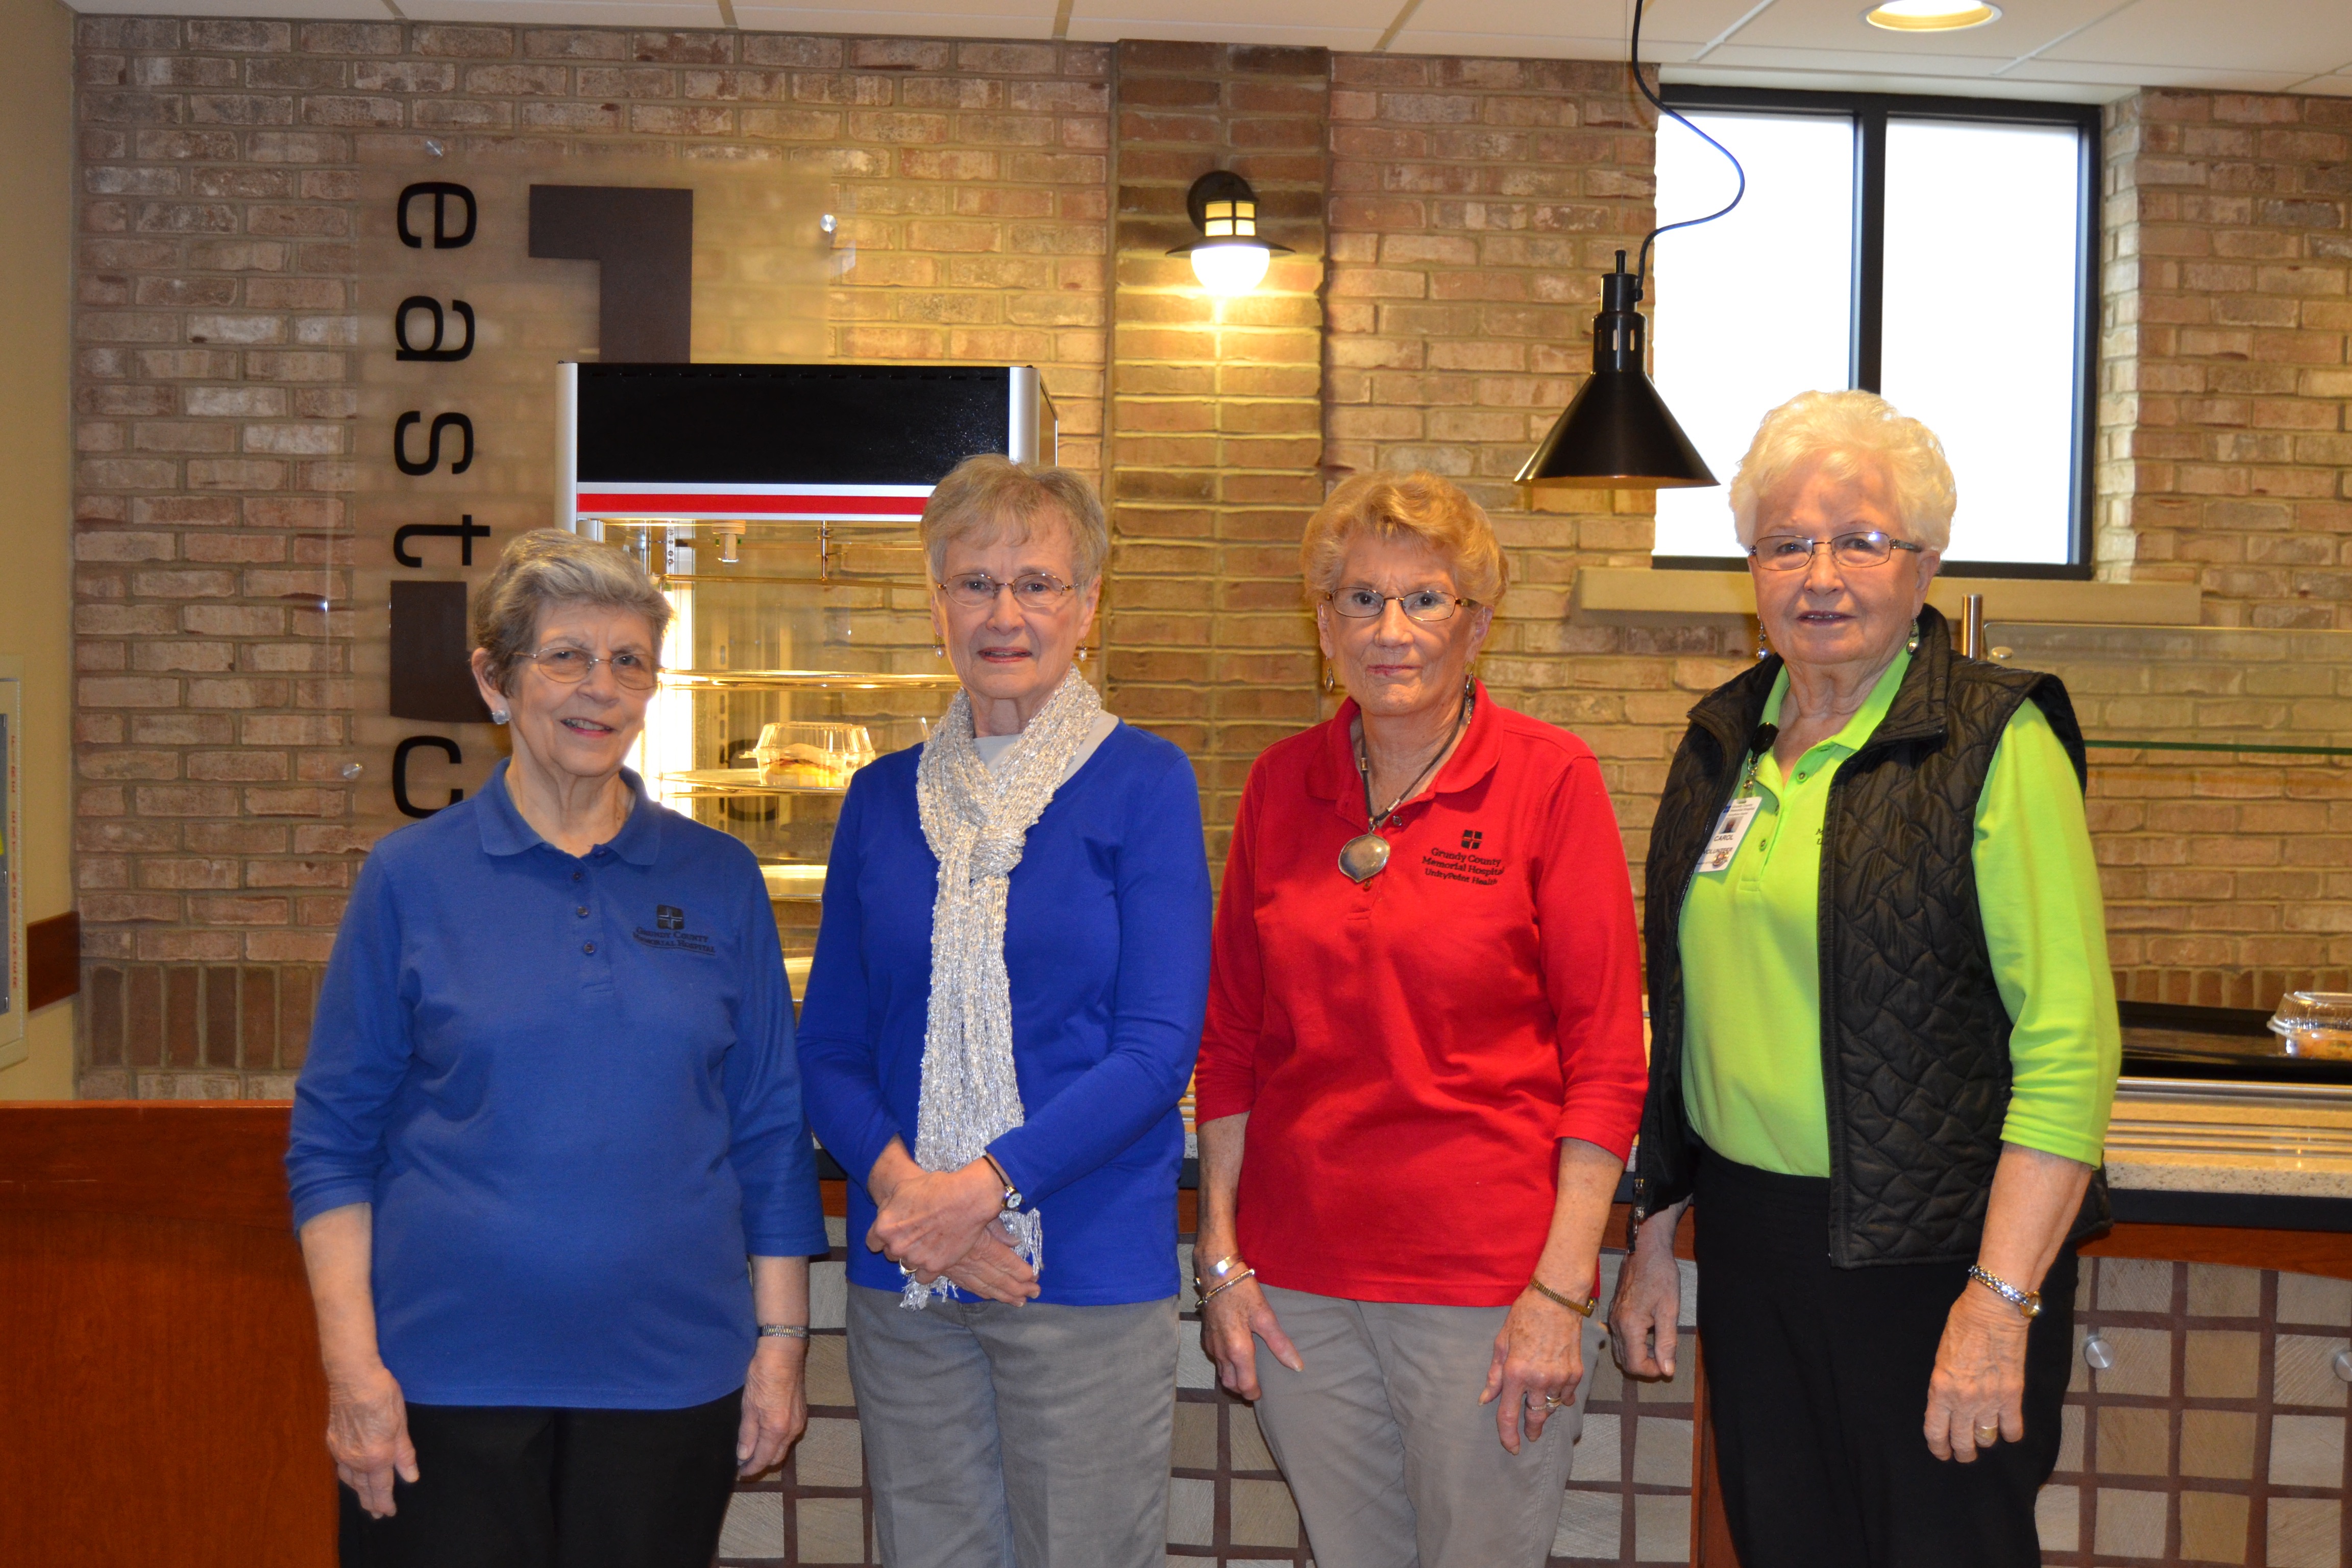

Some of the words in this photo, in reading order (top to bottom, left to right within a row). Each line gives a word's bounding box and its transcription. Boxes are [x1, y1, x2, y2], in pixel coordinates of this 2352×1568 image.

[393, 182, 490, 568] east
[1422, 856, 1466, 872] Memorial
[1468, 865, 1505, 877] Hospital
[1431, 847, 1467, 863] Grundy
[1467, 854, 1502, 867] County
[1425, 868, 1471, 883] UnityPoint
[1472, 876, 1499, 886] Health
[673, 931, 708, 943] COUNTY
